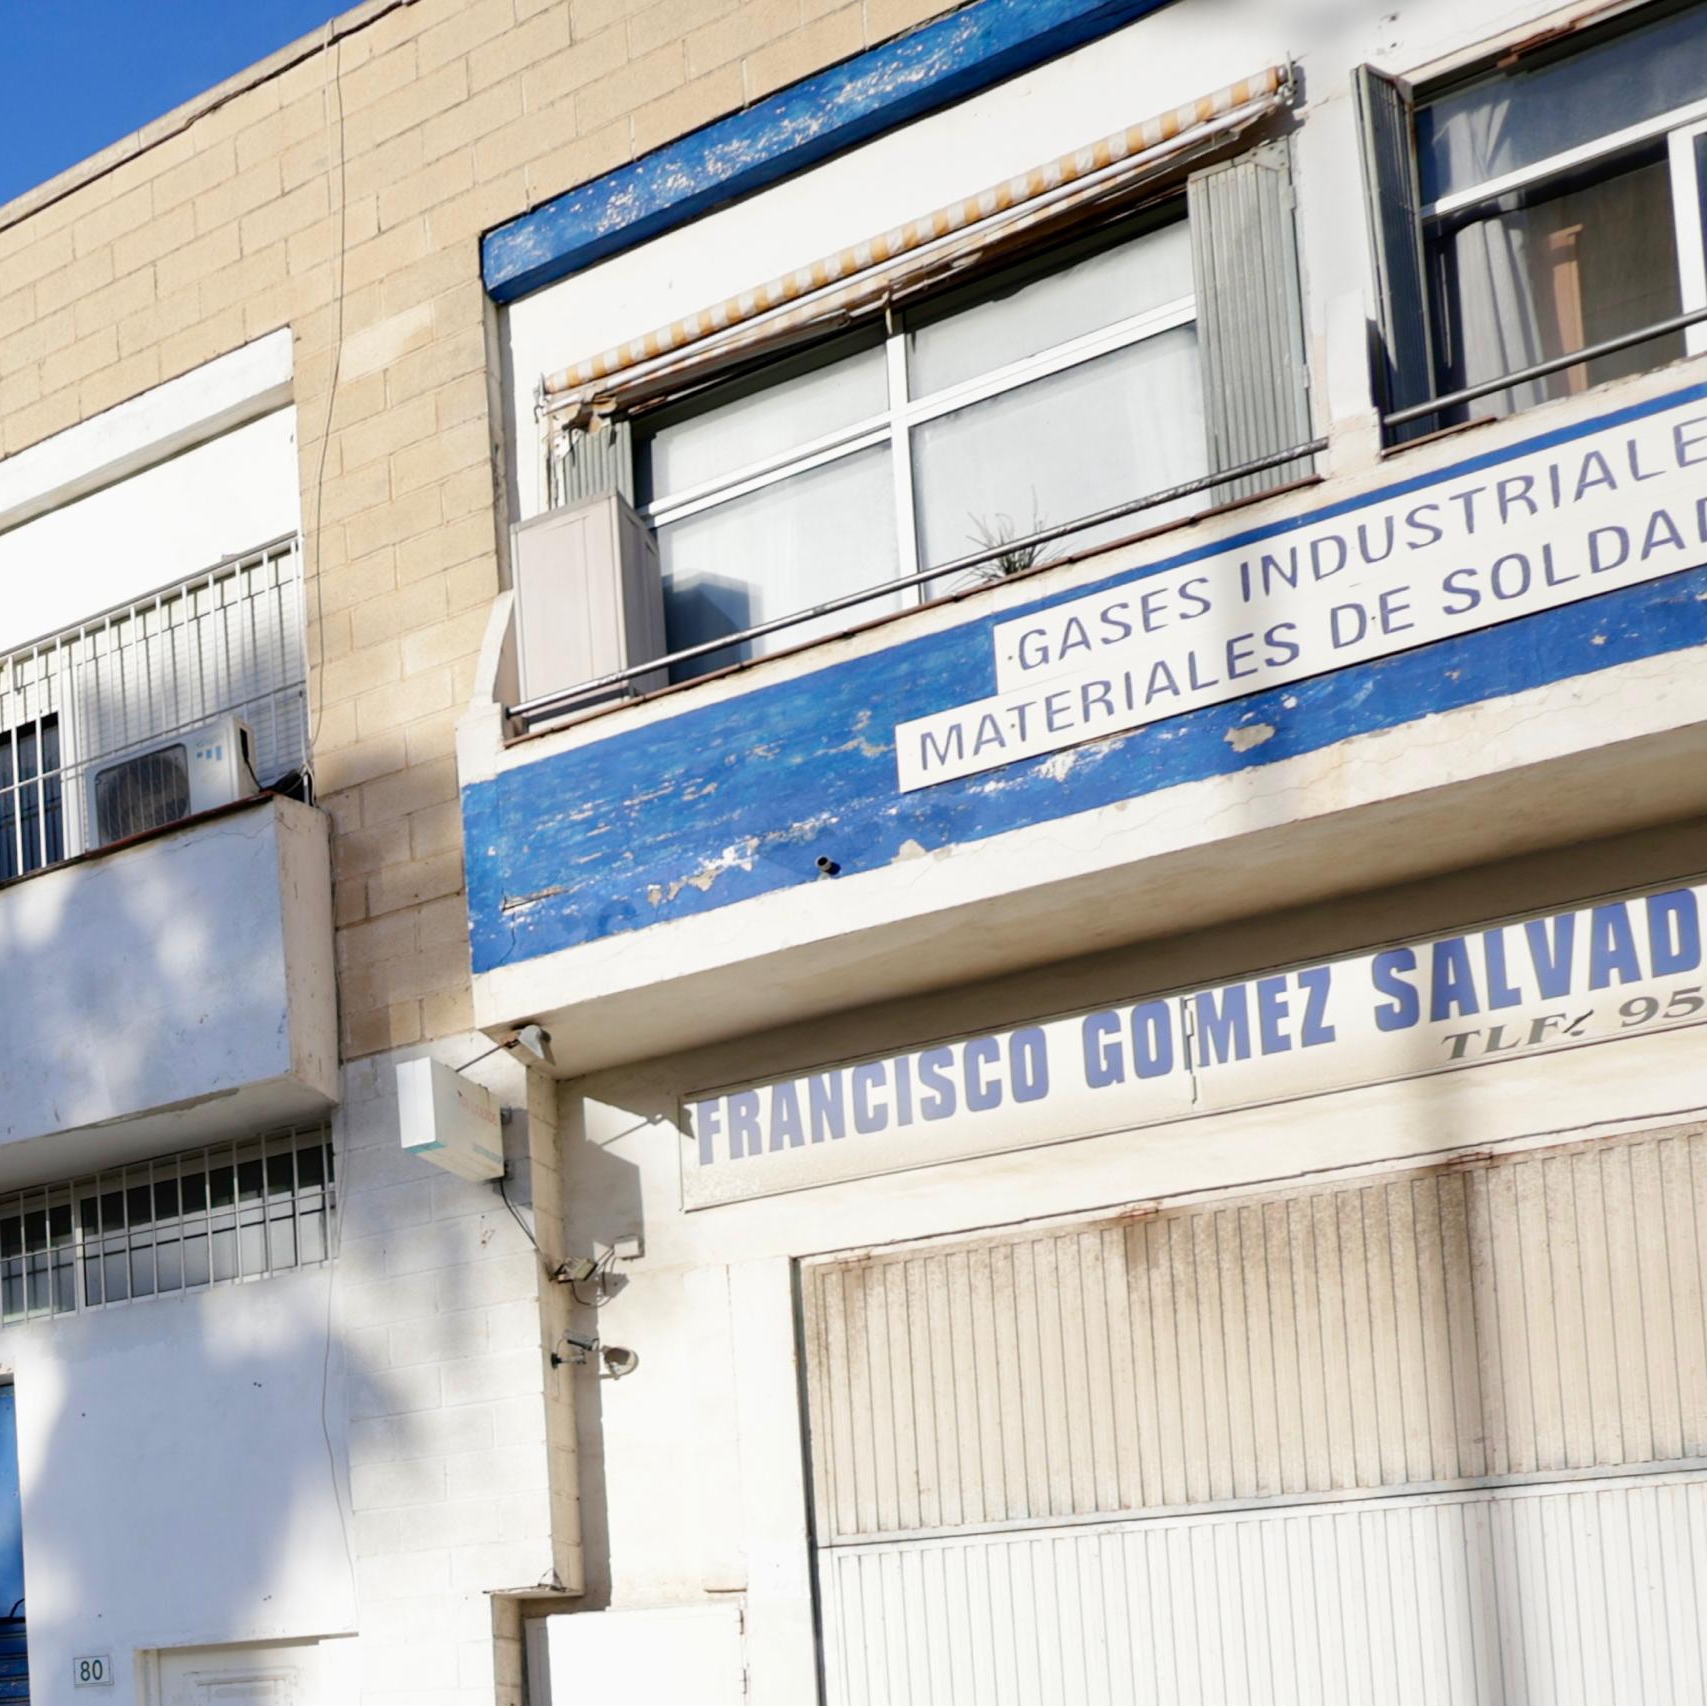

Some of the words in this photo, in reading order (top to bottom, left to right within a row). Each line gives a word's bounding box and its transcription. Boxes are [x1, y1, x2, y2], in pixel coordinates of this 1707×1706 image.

[918, 621, 1299, 772] MATERIALES
[1330, 584, 1414, 650] DE
[1017, 576, 1212, 672] GASES
[698, 1025, 1049, 1167] FRANCISCO
[1082, 966, 1336, 1090] GOMEZ
[79, 1659, 104, 1682] 80
